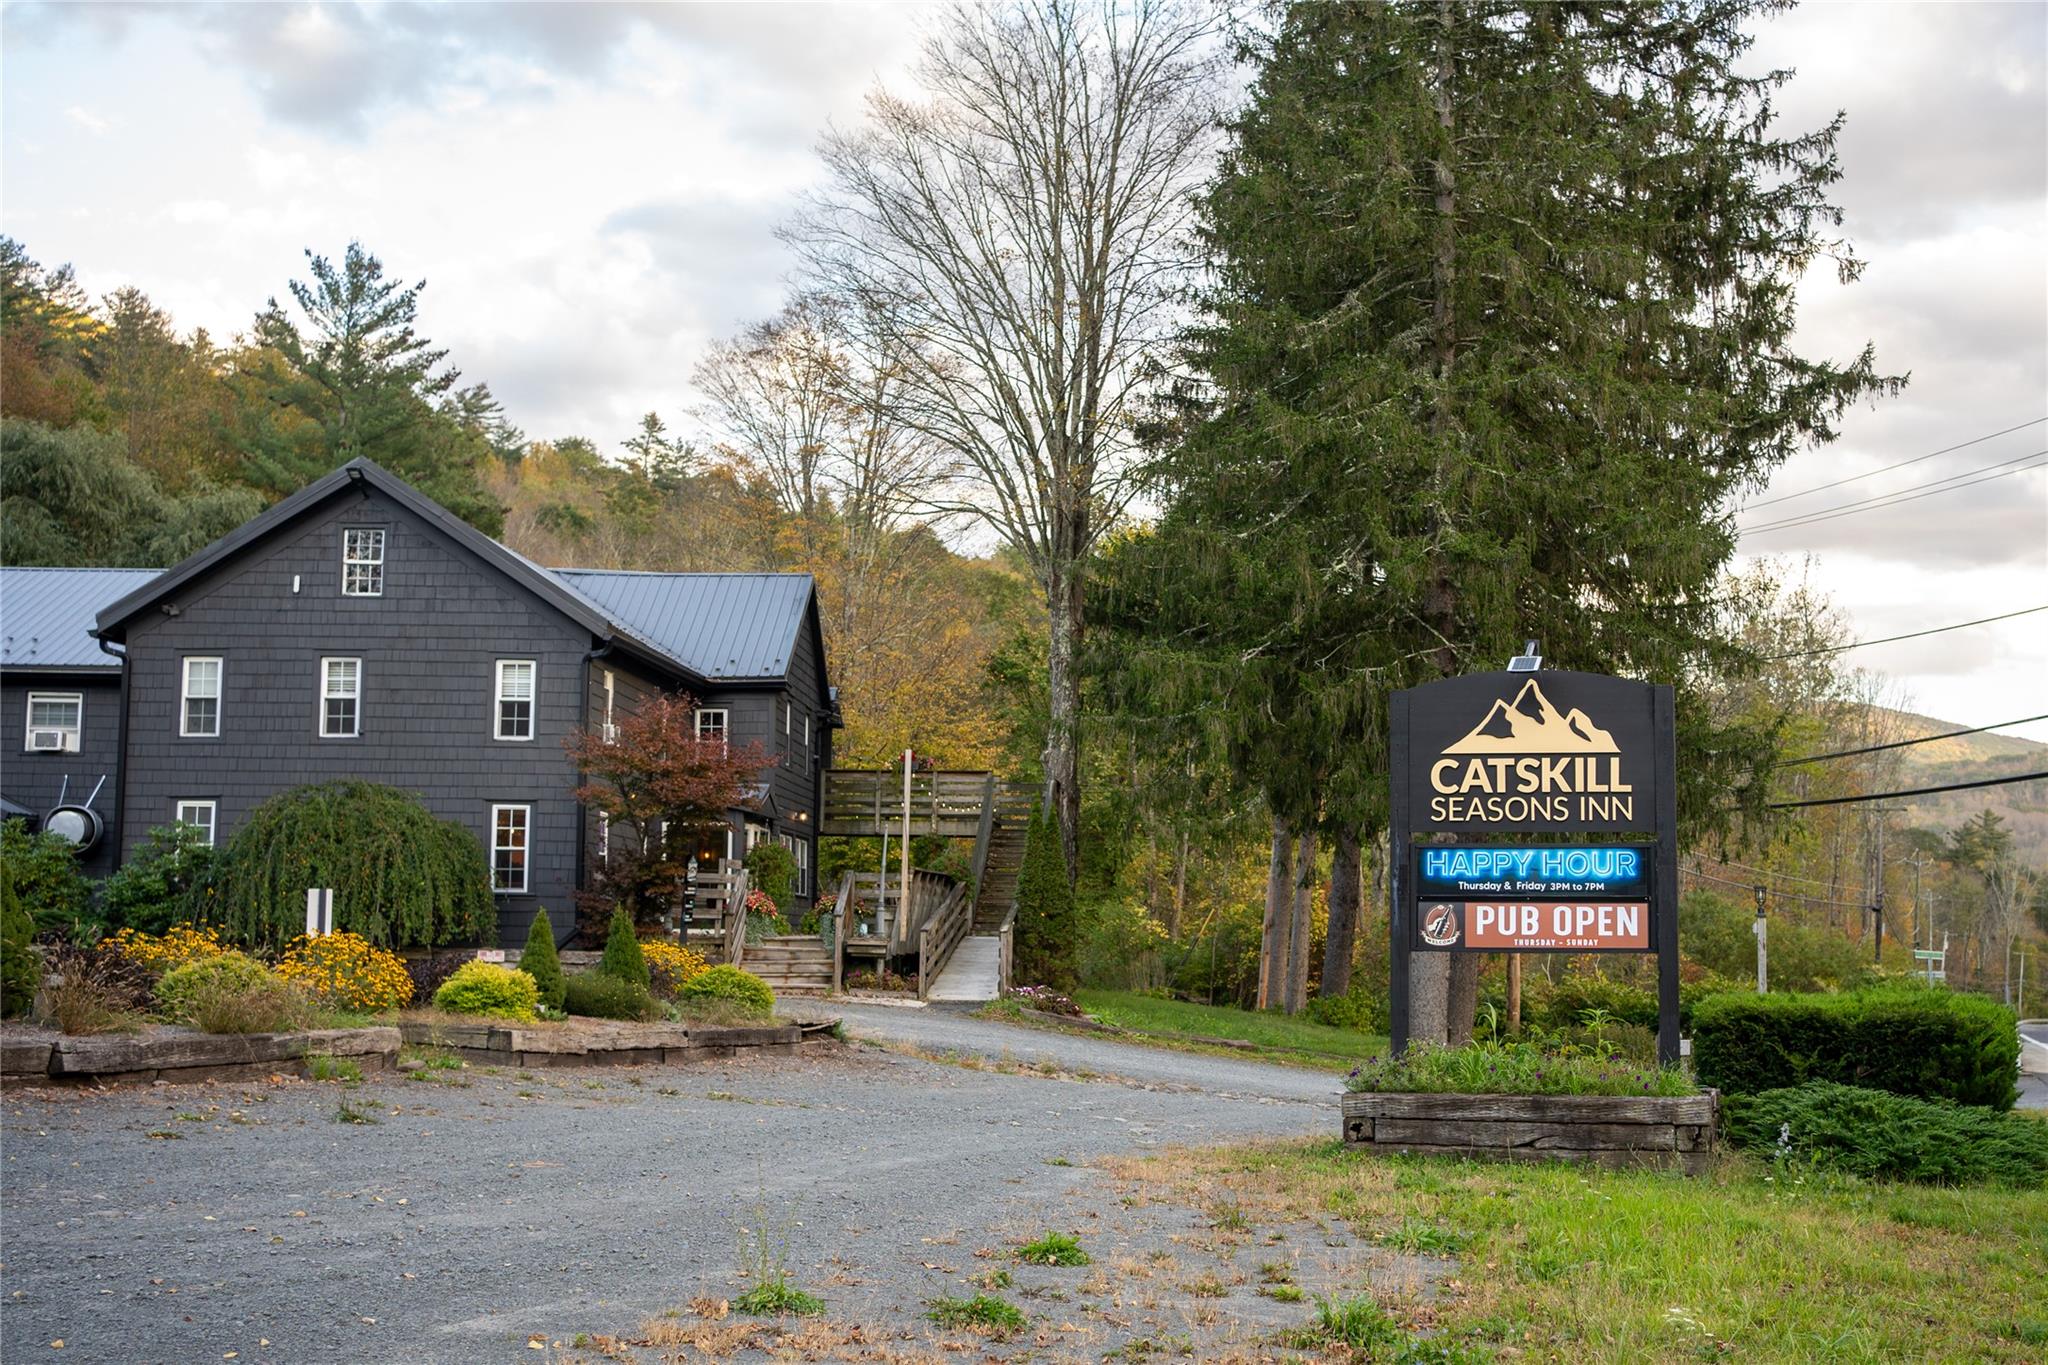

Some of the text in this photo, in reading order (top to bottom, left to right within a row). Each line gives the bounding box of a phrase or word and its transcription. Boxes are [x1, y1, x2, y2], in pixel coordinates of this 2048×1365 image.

[1430, 757, 1632, 794] CATSKILL
[1430, 796, 1633, 822] SEASONS INN
[1427, 851, 1637, 877] HAPPY HOUR
[1458, 881, 1604, 892] Thursday & Friday 3PM to 7PM
[1476, 905, 1639, 937] PUB OPEN
[1514, 938, 1555, 946] THURSDAY
[1566, 938, 1599, 946] SUNDAY
